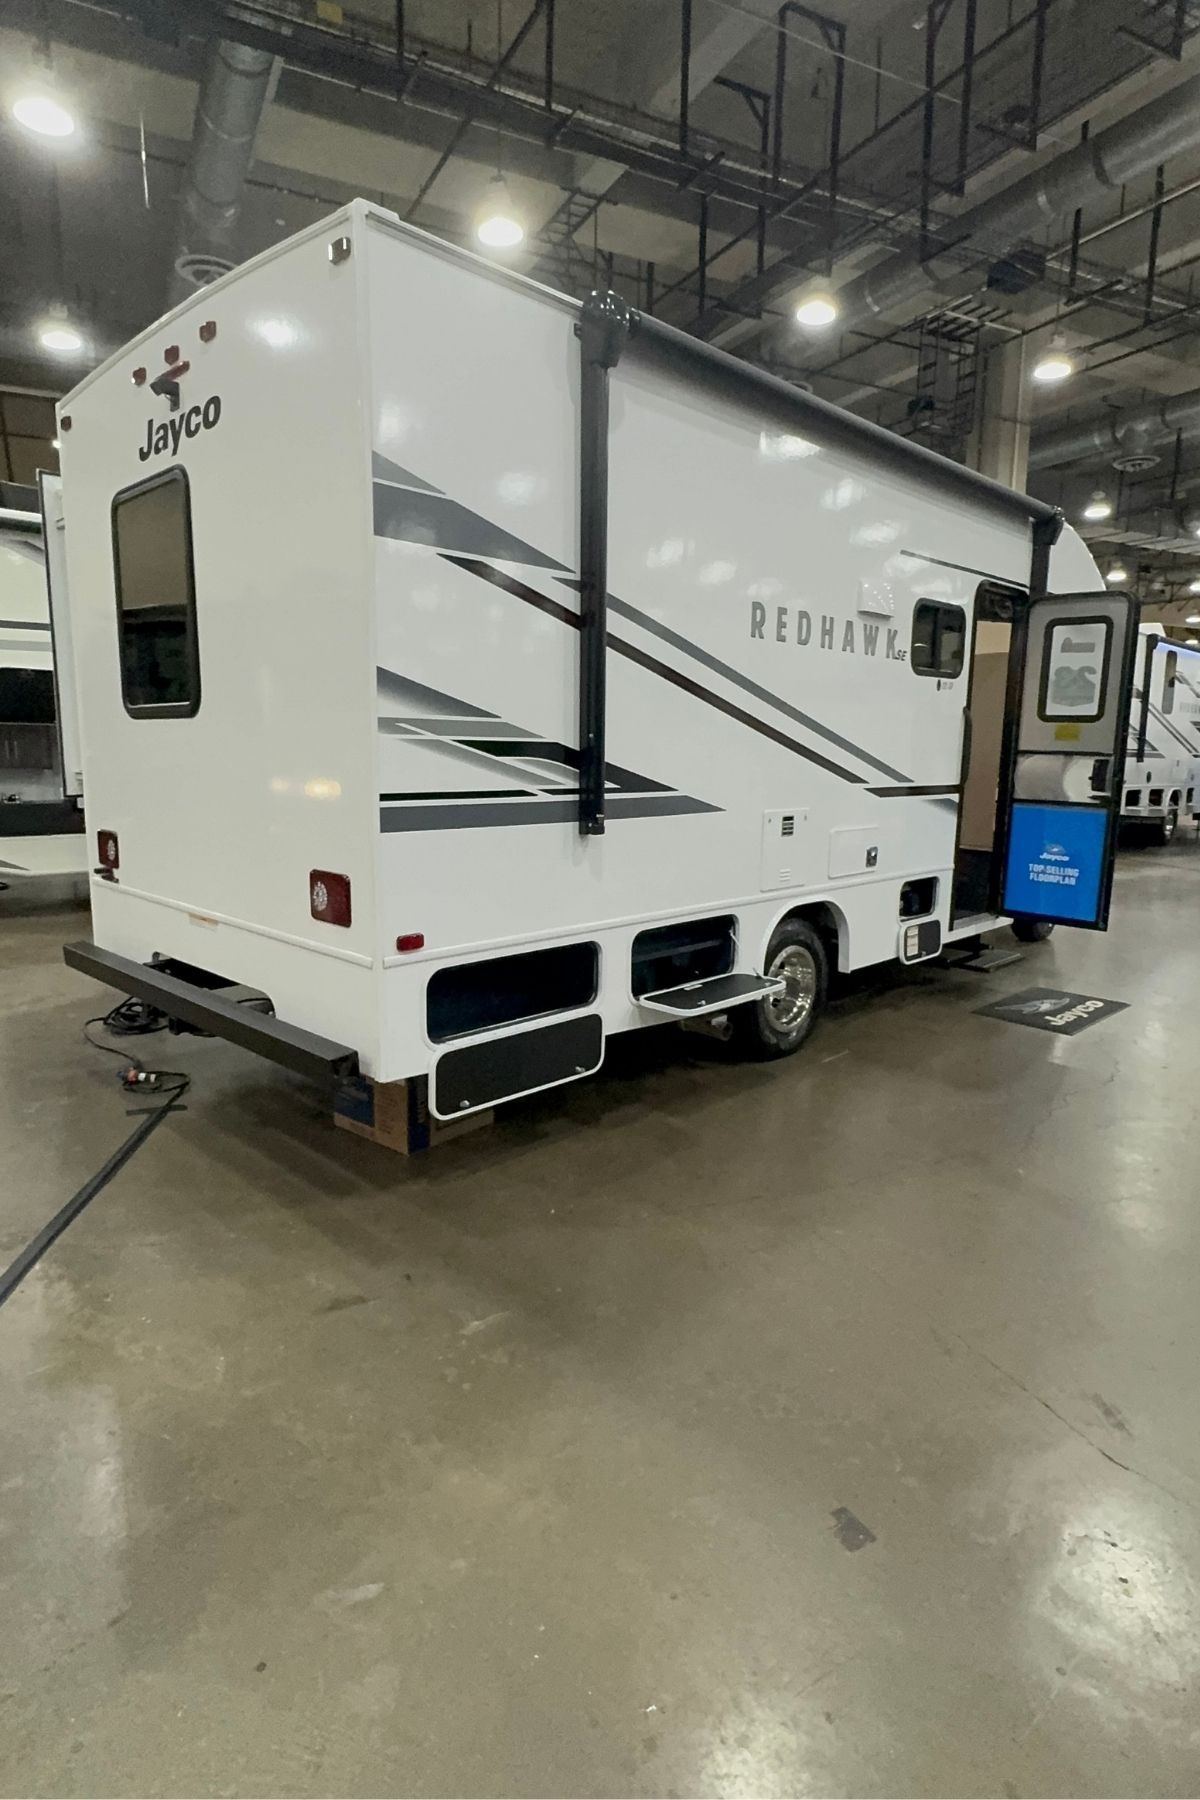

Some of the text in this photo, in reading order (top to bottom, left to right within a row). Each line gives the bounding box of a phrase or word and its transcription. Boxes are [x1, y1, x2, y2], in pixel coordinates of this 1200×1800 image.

[139, 395, 221, 462] Jayco
[750, 601, 899, 660] REDHAWK
[1039, 852, 1070, 862] Jayco
[1029, 872, 1077, 886] FLOORPLAN
[1044, 1000, 1105, 1026] Jayco
